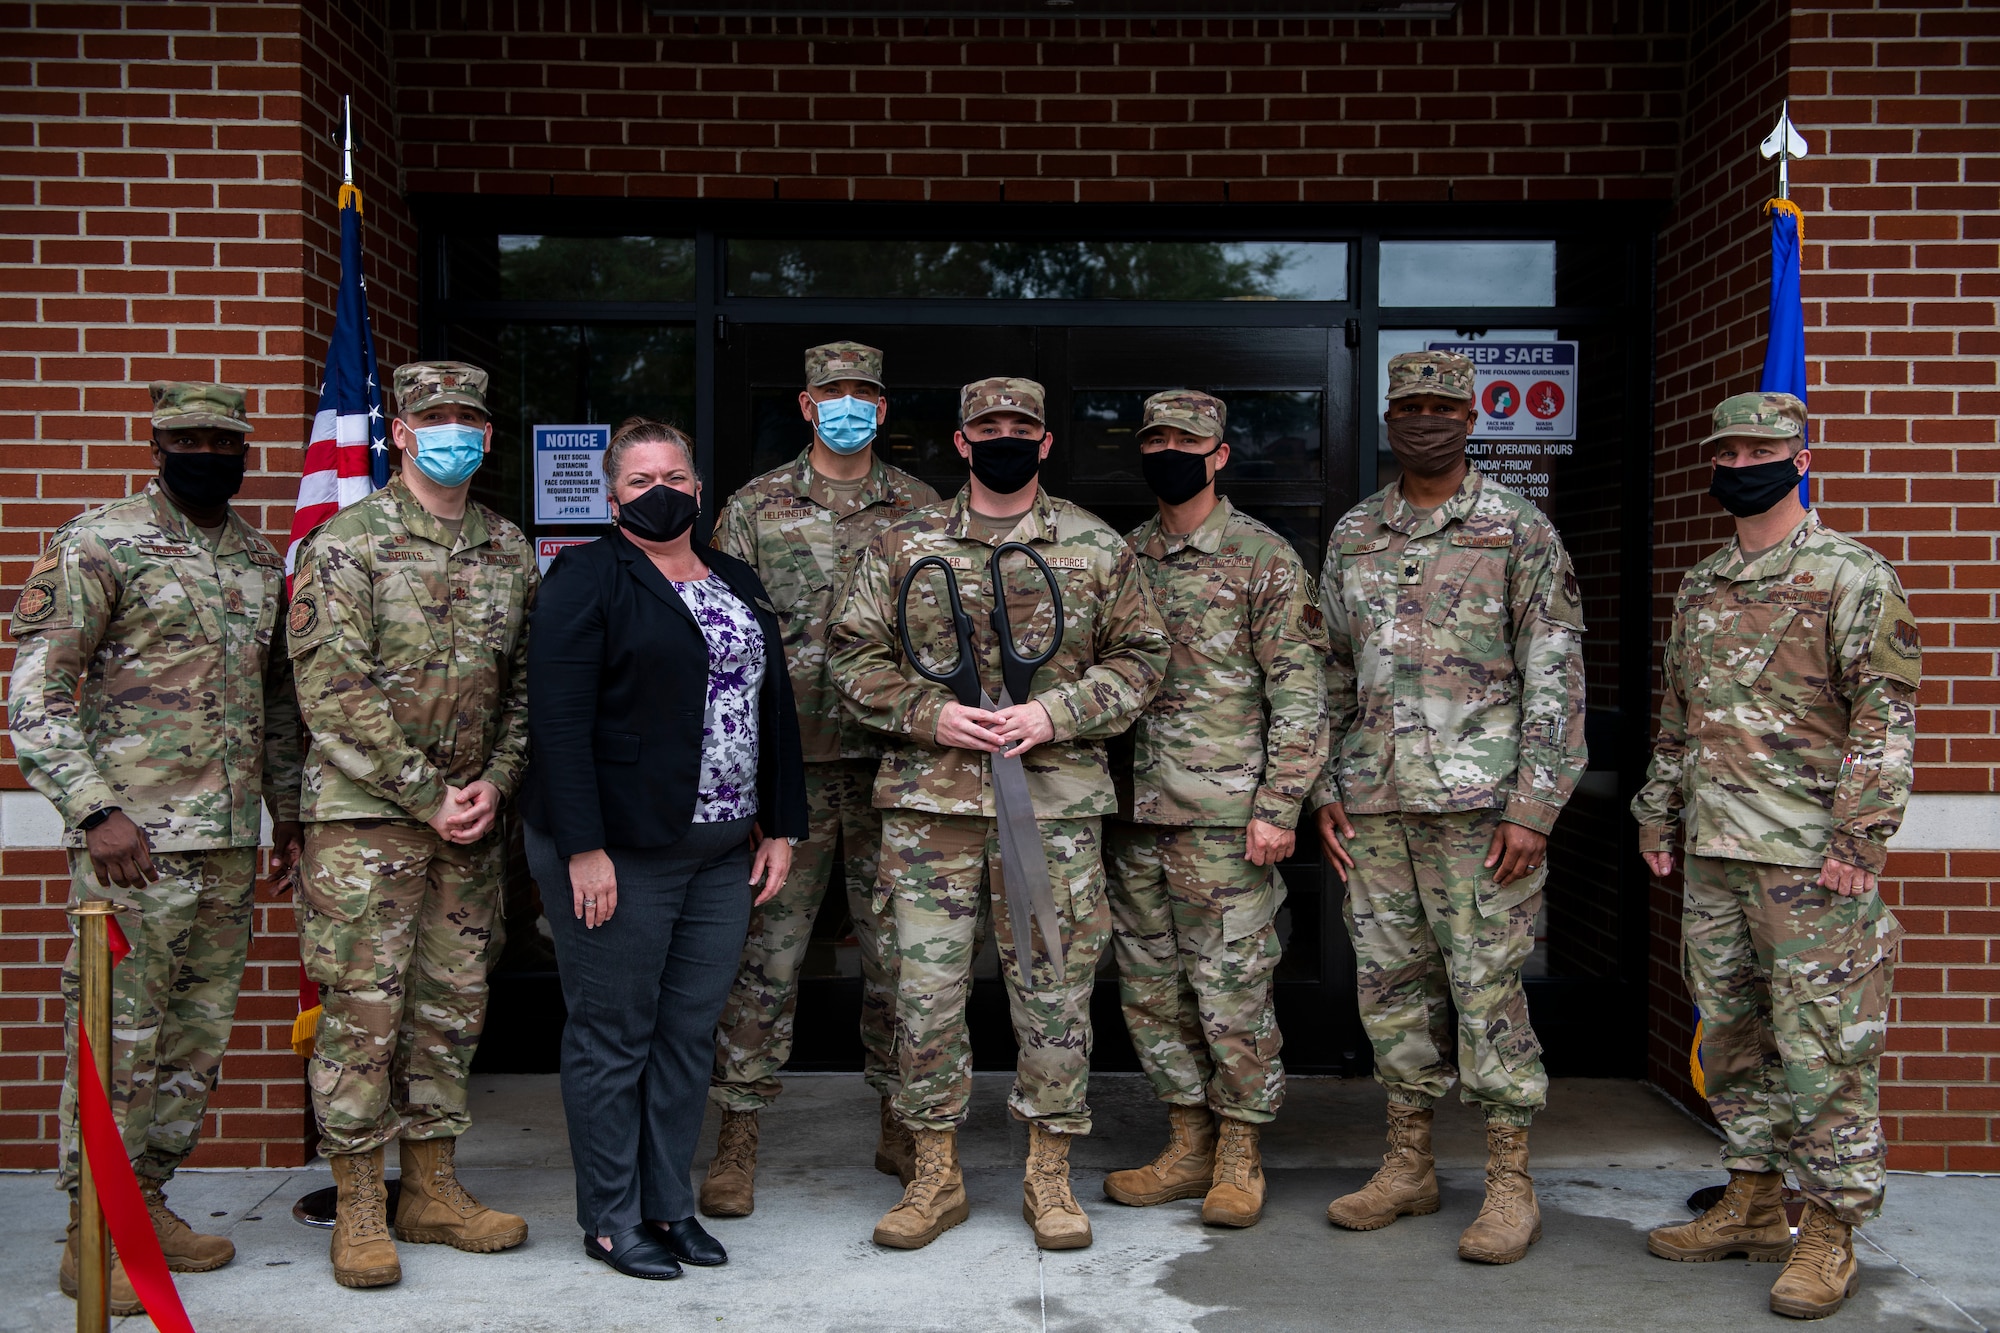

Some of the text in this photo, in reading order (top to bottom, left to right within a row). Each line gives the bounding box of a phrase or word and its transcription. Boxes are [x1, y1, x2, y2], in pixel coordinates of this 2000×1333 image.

[1504, 348, 1554, 363] SAFE
[546, 433, 598, 448] NOTICE
[1464, 444, 1573, 455] ACILITY OPERATING HOURS
[1474, 460, 1532, 470] ONDAY-FRIDAY
[1501, 473, 1549, 484] 0600-0900
[764, 508, 814, 519] HELPHINSTINE
[1473, 536, 1484, 545] AIR
[1487, 536, 1511, 546] FORCE
[1354, 542, 1376, 552] JONES
[387, 551, 424, 560] SPOTTS
[1046, 557, 1057, 566] AIR
[1060, 558, 1084, 567] FORCE
[1785, 592, 1798, 601] AIR
[1800, 591, 1824, 602] FORCE
